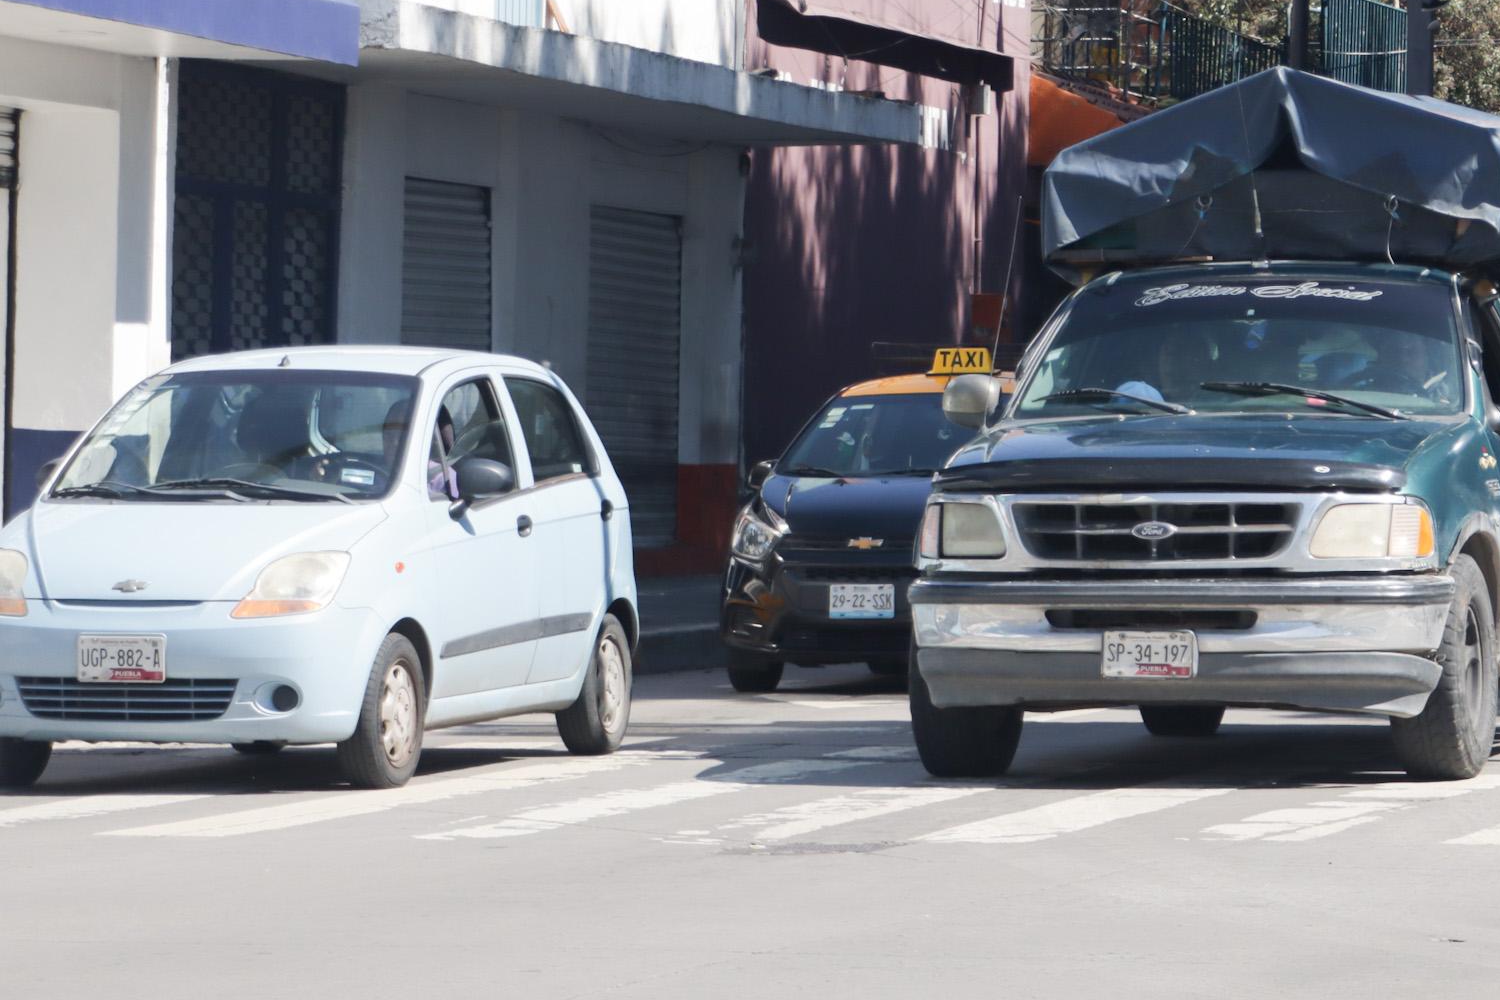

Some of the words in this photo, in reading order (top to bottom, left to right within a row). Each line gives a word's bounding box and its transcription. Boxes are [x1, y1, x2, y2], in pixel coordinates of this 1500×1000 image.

[939, 350, 984, 368] TAXI
[1141, 524, 1164, 536] Ford
[832, 593, 892, 610] 29-22-SSK
[81, 648, 161, 668] UGP-882-A
[1107, 642, 1189, 663] SP-34-197
[1140, 665, 1168, 673] PUEBLA
